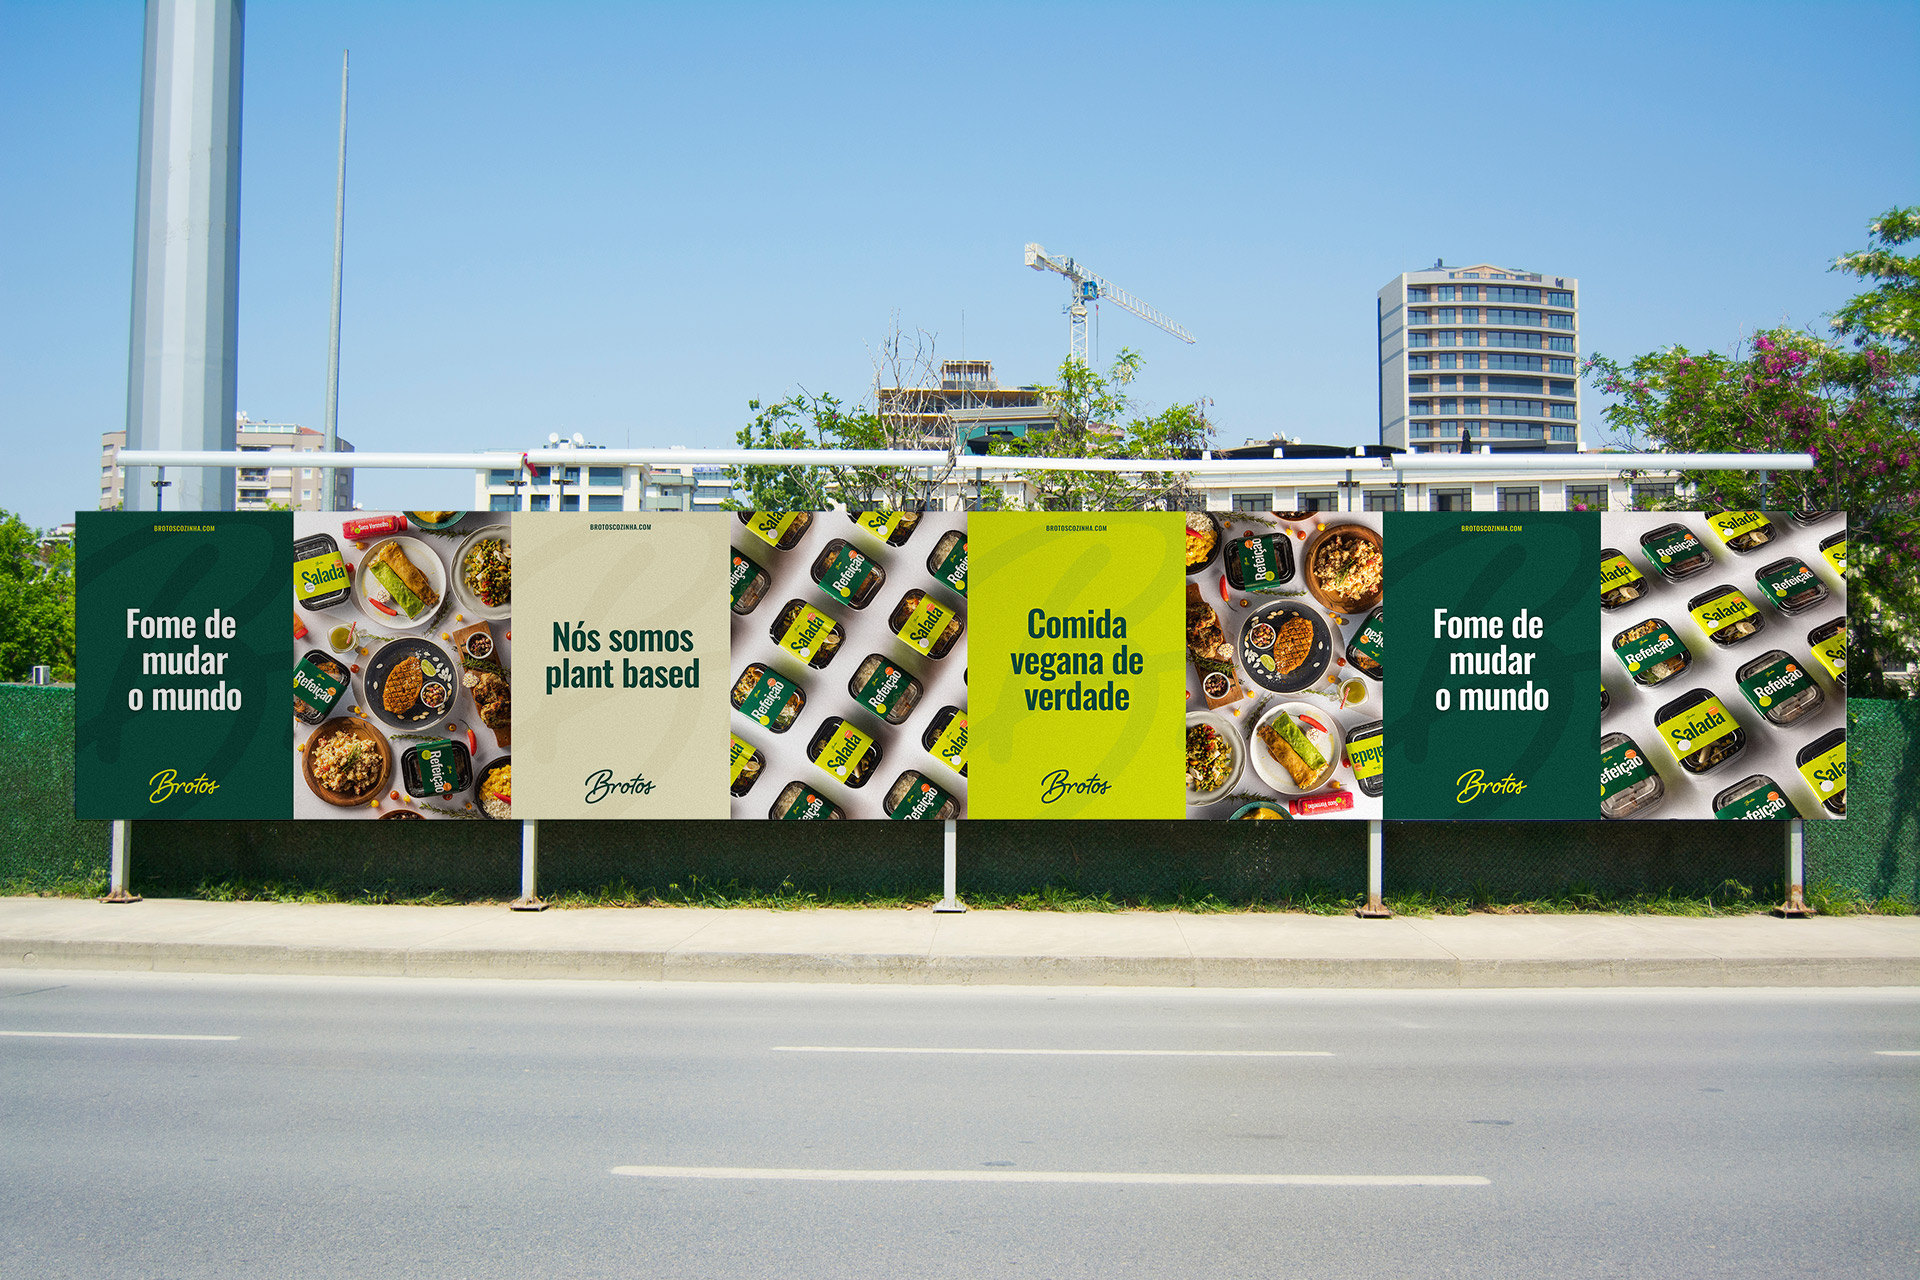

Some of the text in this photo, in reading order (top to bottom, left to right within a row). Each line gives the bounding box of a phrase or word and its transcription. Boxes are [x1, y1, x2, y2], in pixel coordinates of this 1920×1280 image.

[589, 523, 652, 531] BROTOSCOZINHA.COM
[1718, 511, 1760, 532] Salada
[1250, 538, 1267, 581] Refeição
[1656, 537, 1699, 558] Refeição
[301, 564, 345, 586] Salada
[832, 553, 865, 591] Refeição
[1771, 571, 1814, 591] Refeição
[127, 609, 236, 638] Fome de
[909, 607, 944, 645] Salada
[1027, 608, 1127, 639] Comida
[1434, 609, 1544, 638] Fome de
[1702, 601, 1748, 624] Salada
[553, 621, 694, 652] Nós somos
[790, 616, 825, 653] Salada
[142, 645, 229, 674] mudar
[1010, 645, 1144, 682] vegana de
[1450, 645, 1536, 674] mudar
[1625, 638, 1674, 665] Refeição
[295, 670, 333, 704] Refeição
[546, 658, 700, 695] plant based
[868, 670, 902, 708] Refeição
[1753, 669, 1803, 698] Refeição
[128, 681, 242, 710] o mundo
[751, 681, 785, 720] Refeição
[1024, 681, 1130, 711] verdade
[1435, 681, 1549, 710] o mundo
[1671, 712, 1726, 745] Salada
[827, 733, 862, 773] Salada
[149, 769, 220, 804] Brotos
[429, 750, 446, 793] Refeição
[584, 769, 657, 804] Brotos
[1040, 769, 1112, 804] Brotos
[1456, 769, 1527, 804] Brotos
